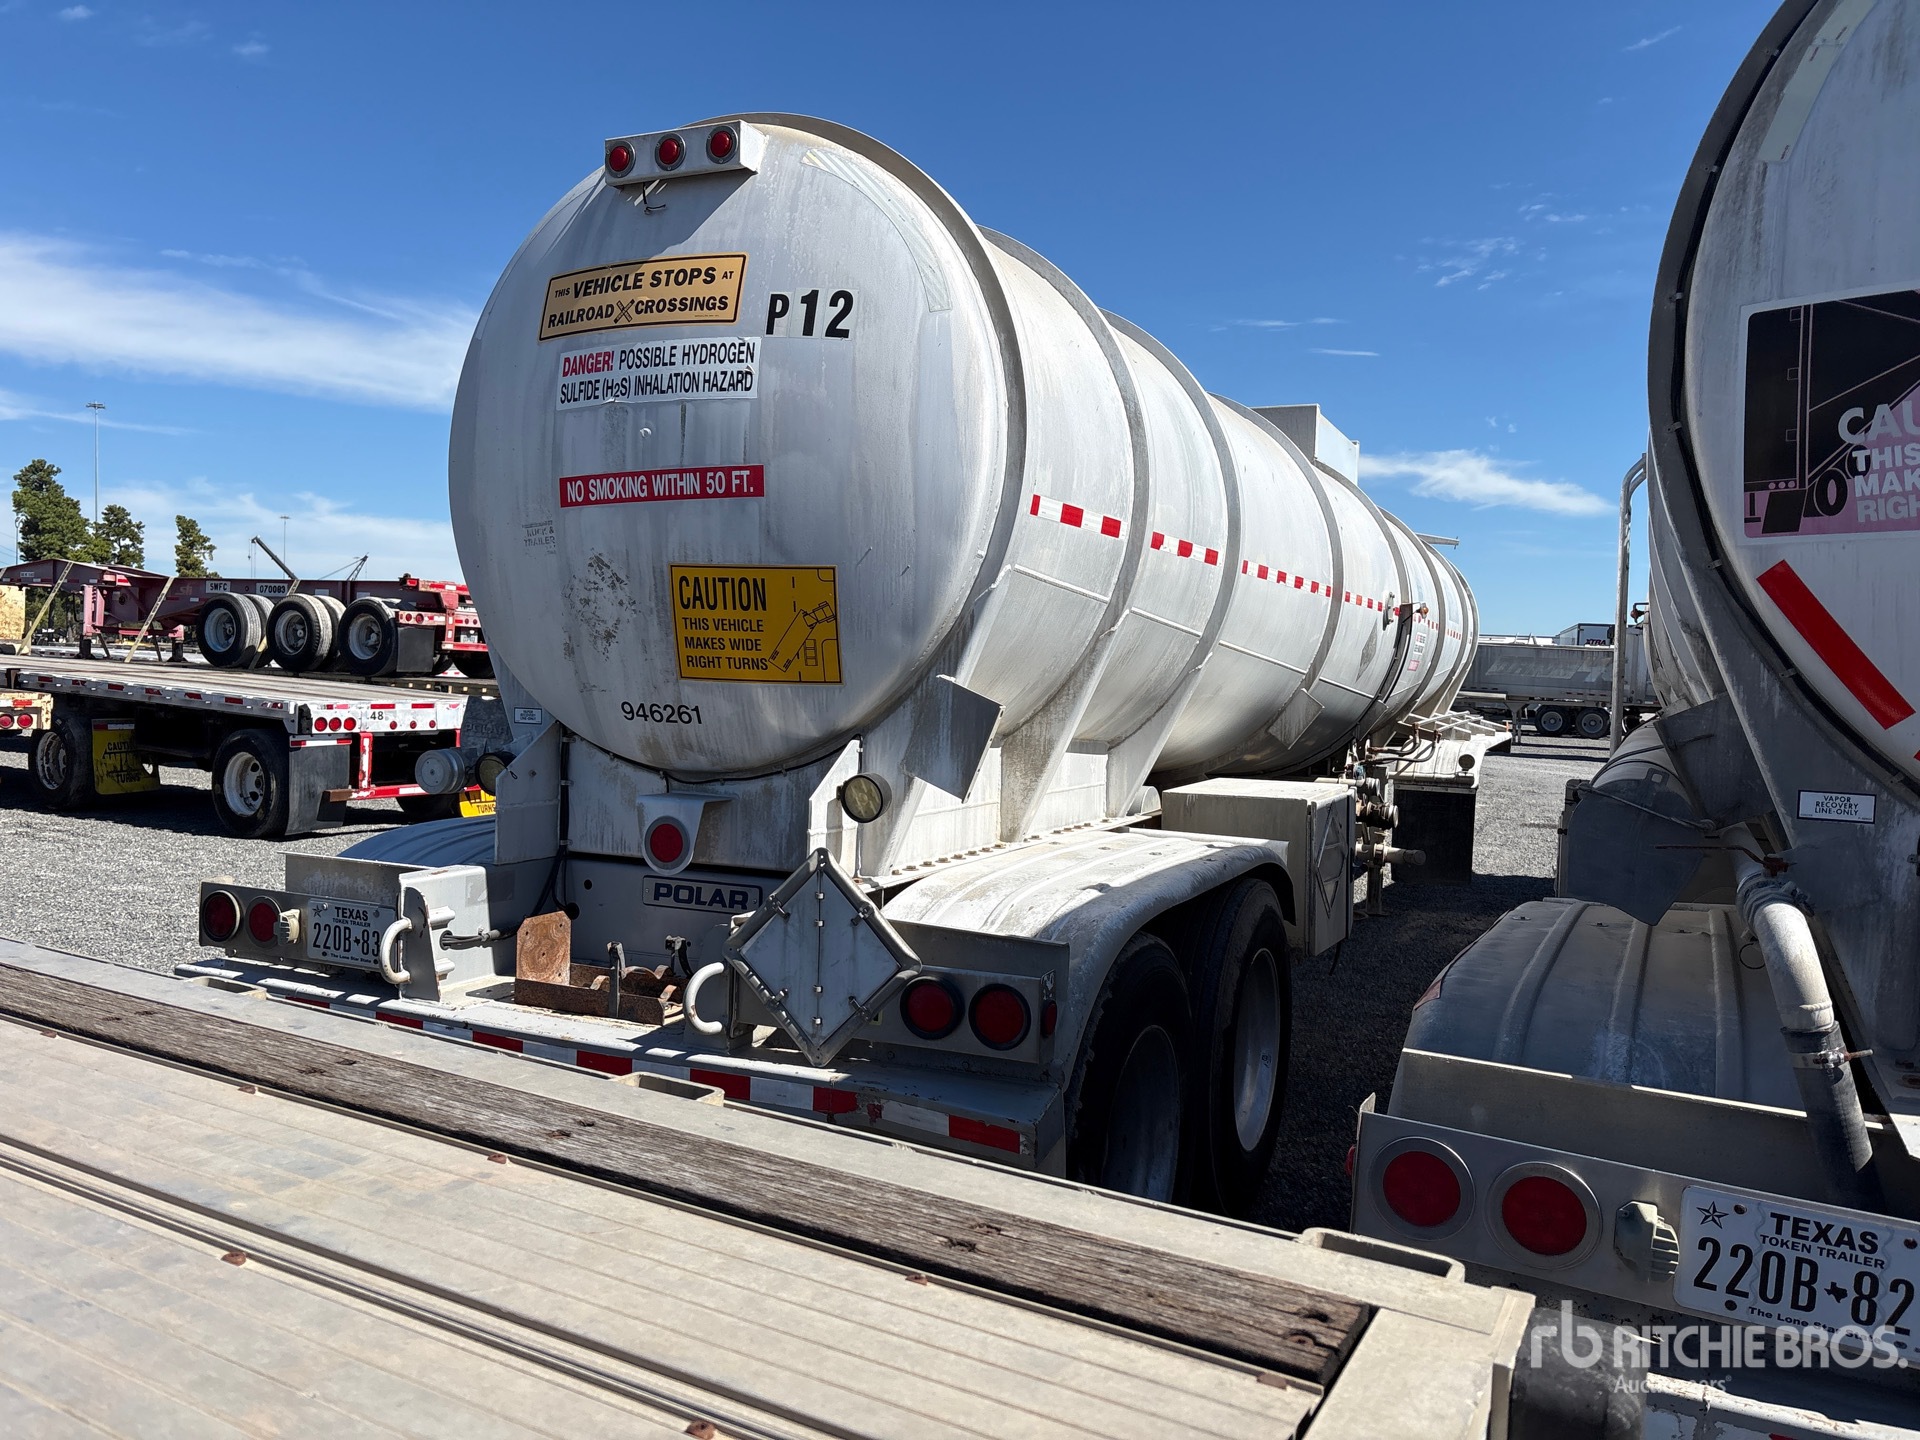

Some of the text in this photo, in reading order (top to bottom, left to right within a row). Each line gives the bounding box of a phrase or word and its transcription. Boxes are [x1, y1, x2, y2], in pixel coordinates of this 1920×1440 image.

[554, 266, 734, 299] THIS VEHICLE STOPS AT
[548, 296, 729, 328] RAILROAD CROSSINGS
[765, 289, 854, 339] P12
[562, 342, 756, 378] DANGER! POSSIBLE HYDROGEN
[560, 370, 754, 404] SULFIDE (H2S) INHALATION HAZARD
[566, 470, 754, 503] NO SMOKING WITHIN 50 FT.
[678, 575, 768, 612] CAUTION
[682, 616, 764, 634] THIS VEHICLE
[684, 636, 762, 652] MAKES WIDE
[686, 655, 769, 672] RIGHT TURNS
[370, 710, 384, 720] 48
[620, 700, 703, 725] 946261
[1814, 808, 1859, 816] LINE-ONLY
[1815, 800, 1859, 810] RECOVERY
[654, 882, 749, 910] POLAR
[334, 906, 368, 922] TEXAS
[350, 920, 371, 928] TRAILER
[312, 922, 352, 953] 220B
[1770, 1212, 1879, 1254] TEXAS
[1760, 1234, 1886, 1270] TOKEN TRAILER
[1693, 1236, 1819, 1313] 220B
[1748, 1306, 1882, 1344] The Lone Star State
